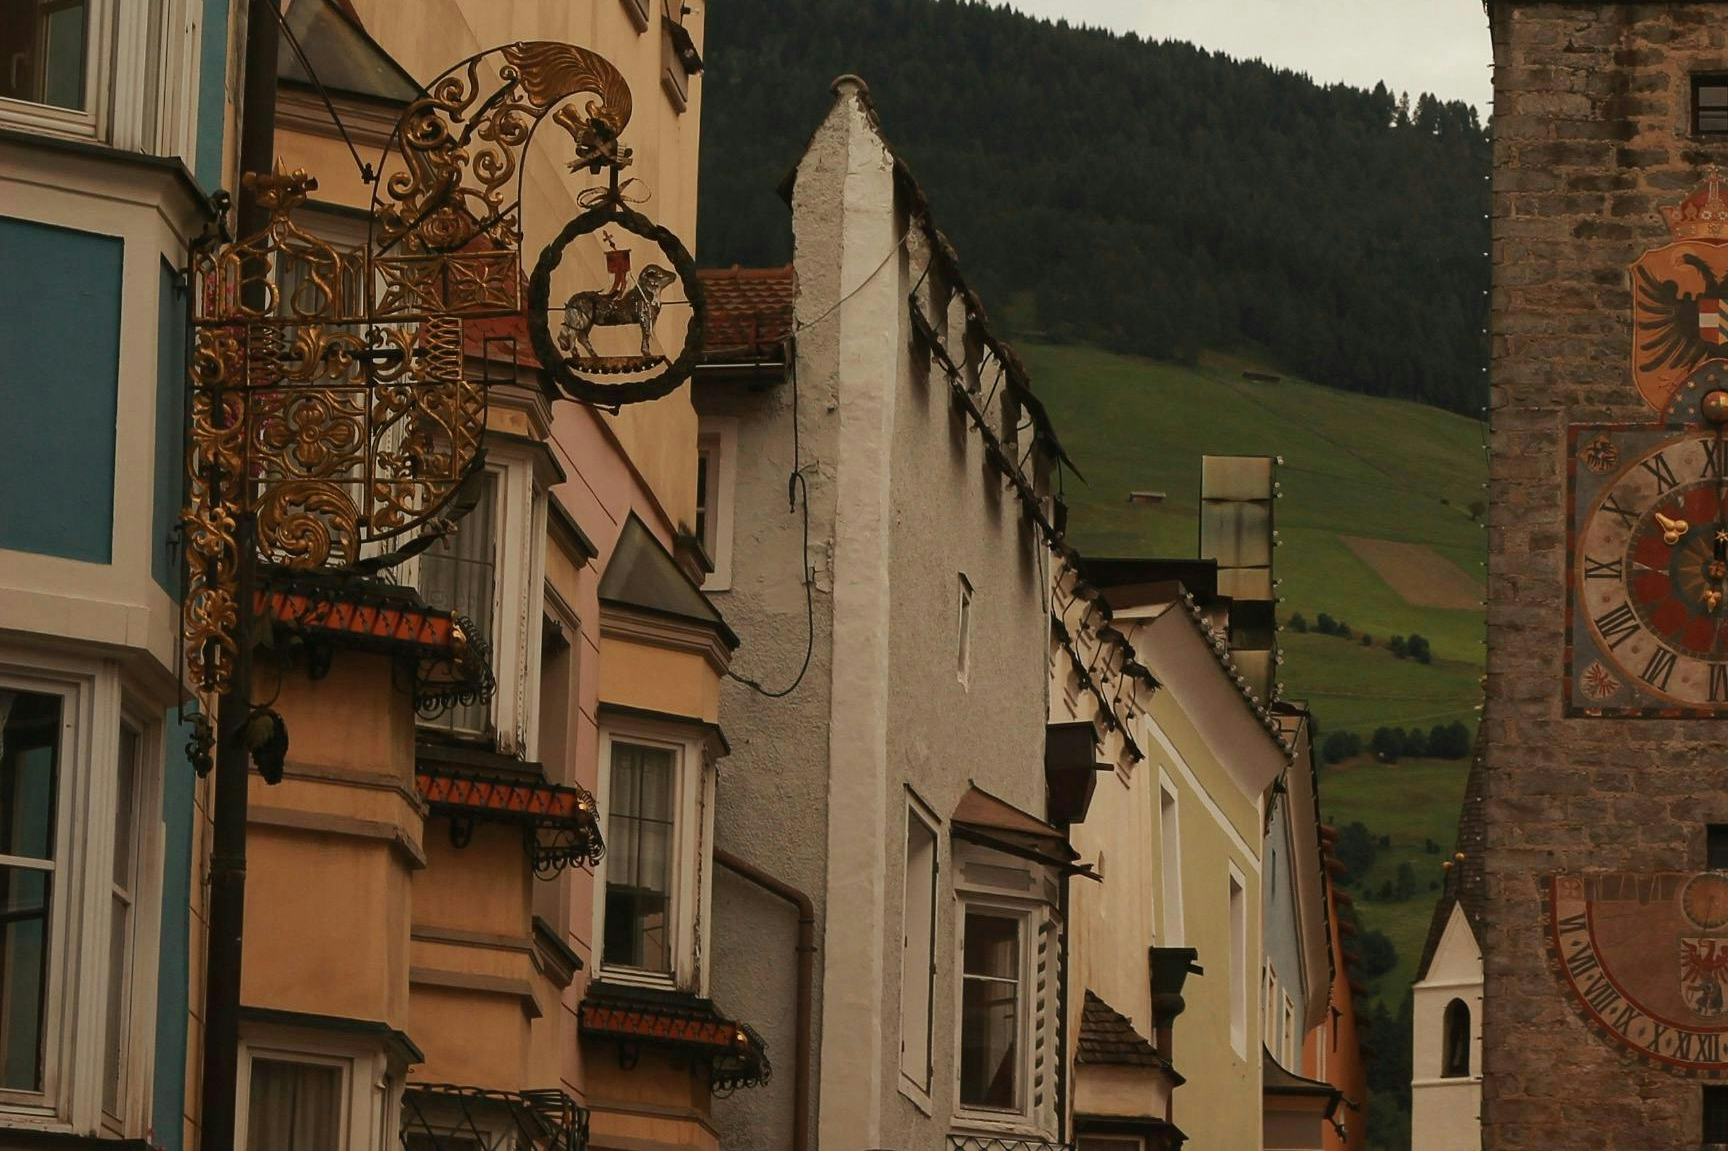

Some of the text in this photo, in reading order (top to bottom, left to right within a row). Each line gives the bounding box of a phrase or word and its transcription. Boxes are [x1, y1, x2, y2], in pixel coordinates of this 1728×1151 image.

[1640, 451, 1679, 496] XI
[1600, 492, 1641, 531] X
[1584, 554, 1622, 582] IX
[1593, 600, 1641, 652] VIII
[1639, 644, 1678, 692] VII
[1567, 942, 1599, 979] VII
[1583, 974, 1621, 1013] VIII
[1611, 1005, 1644, 1037] IX
[1647, 1022, 1669, 1052] X
[1670, 1030, 1692, 1060] XI
[1693, 1034, 1721, 1062] XII
